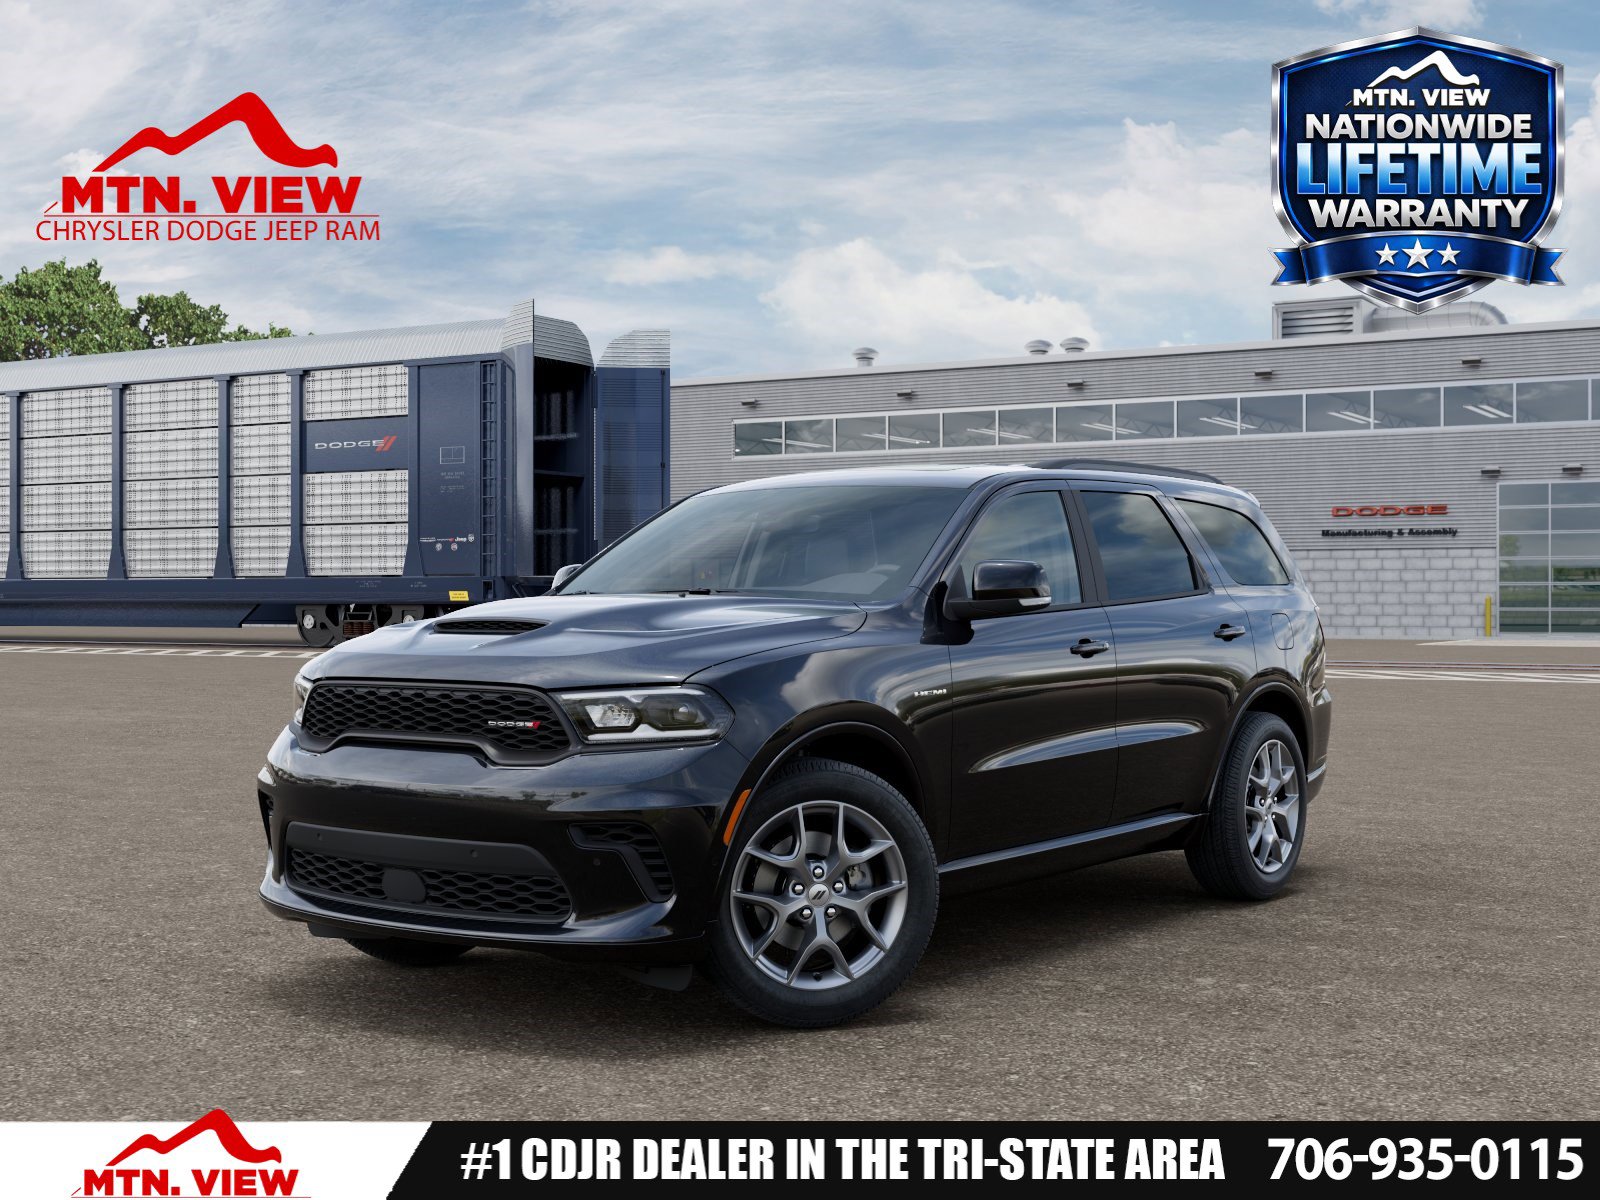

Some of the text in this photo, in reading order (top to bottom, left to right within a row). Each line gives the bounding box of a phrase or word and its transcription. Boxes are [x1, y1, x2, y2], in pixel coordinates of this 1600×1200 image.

[314, 439, 385, 450] DODGE
[1331, 504, 1448, 518] DODGE
[1321, 527, 1458, 539] Manufacturing & Assembly
